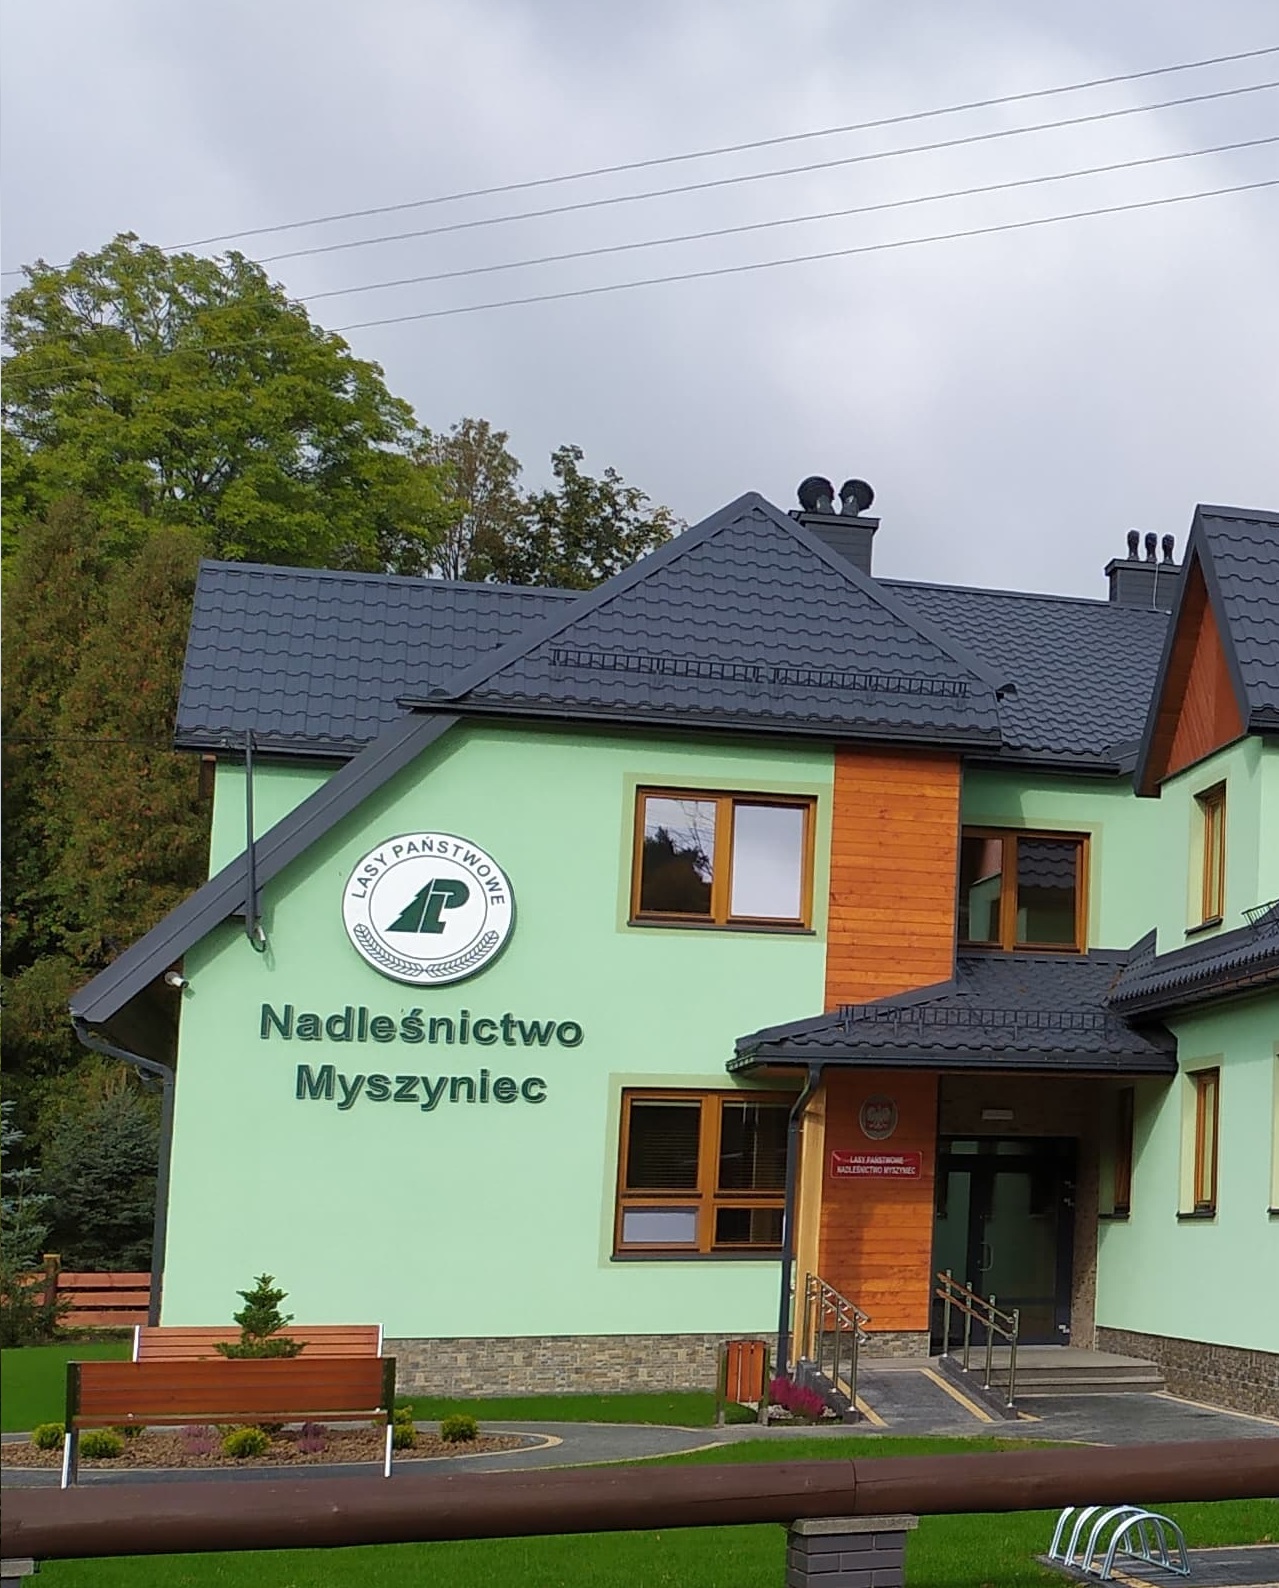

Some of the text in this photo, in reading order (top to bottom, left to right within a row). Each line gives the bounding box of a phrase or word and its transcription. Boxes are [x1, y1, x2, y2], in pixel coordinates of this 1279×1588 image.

[351, 836, 506, 906] LASY PAŃSTWOWE
[260, 1003, 584, 1047] Nadleśnictwo
[296, 1064, 548, 1112] Myszyniec
